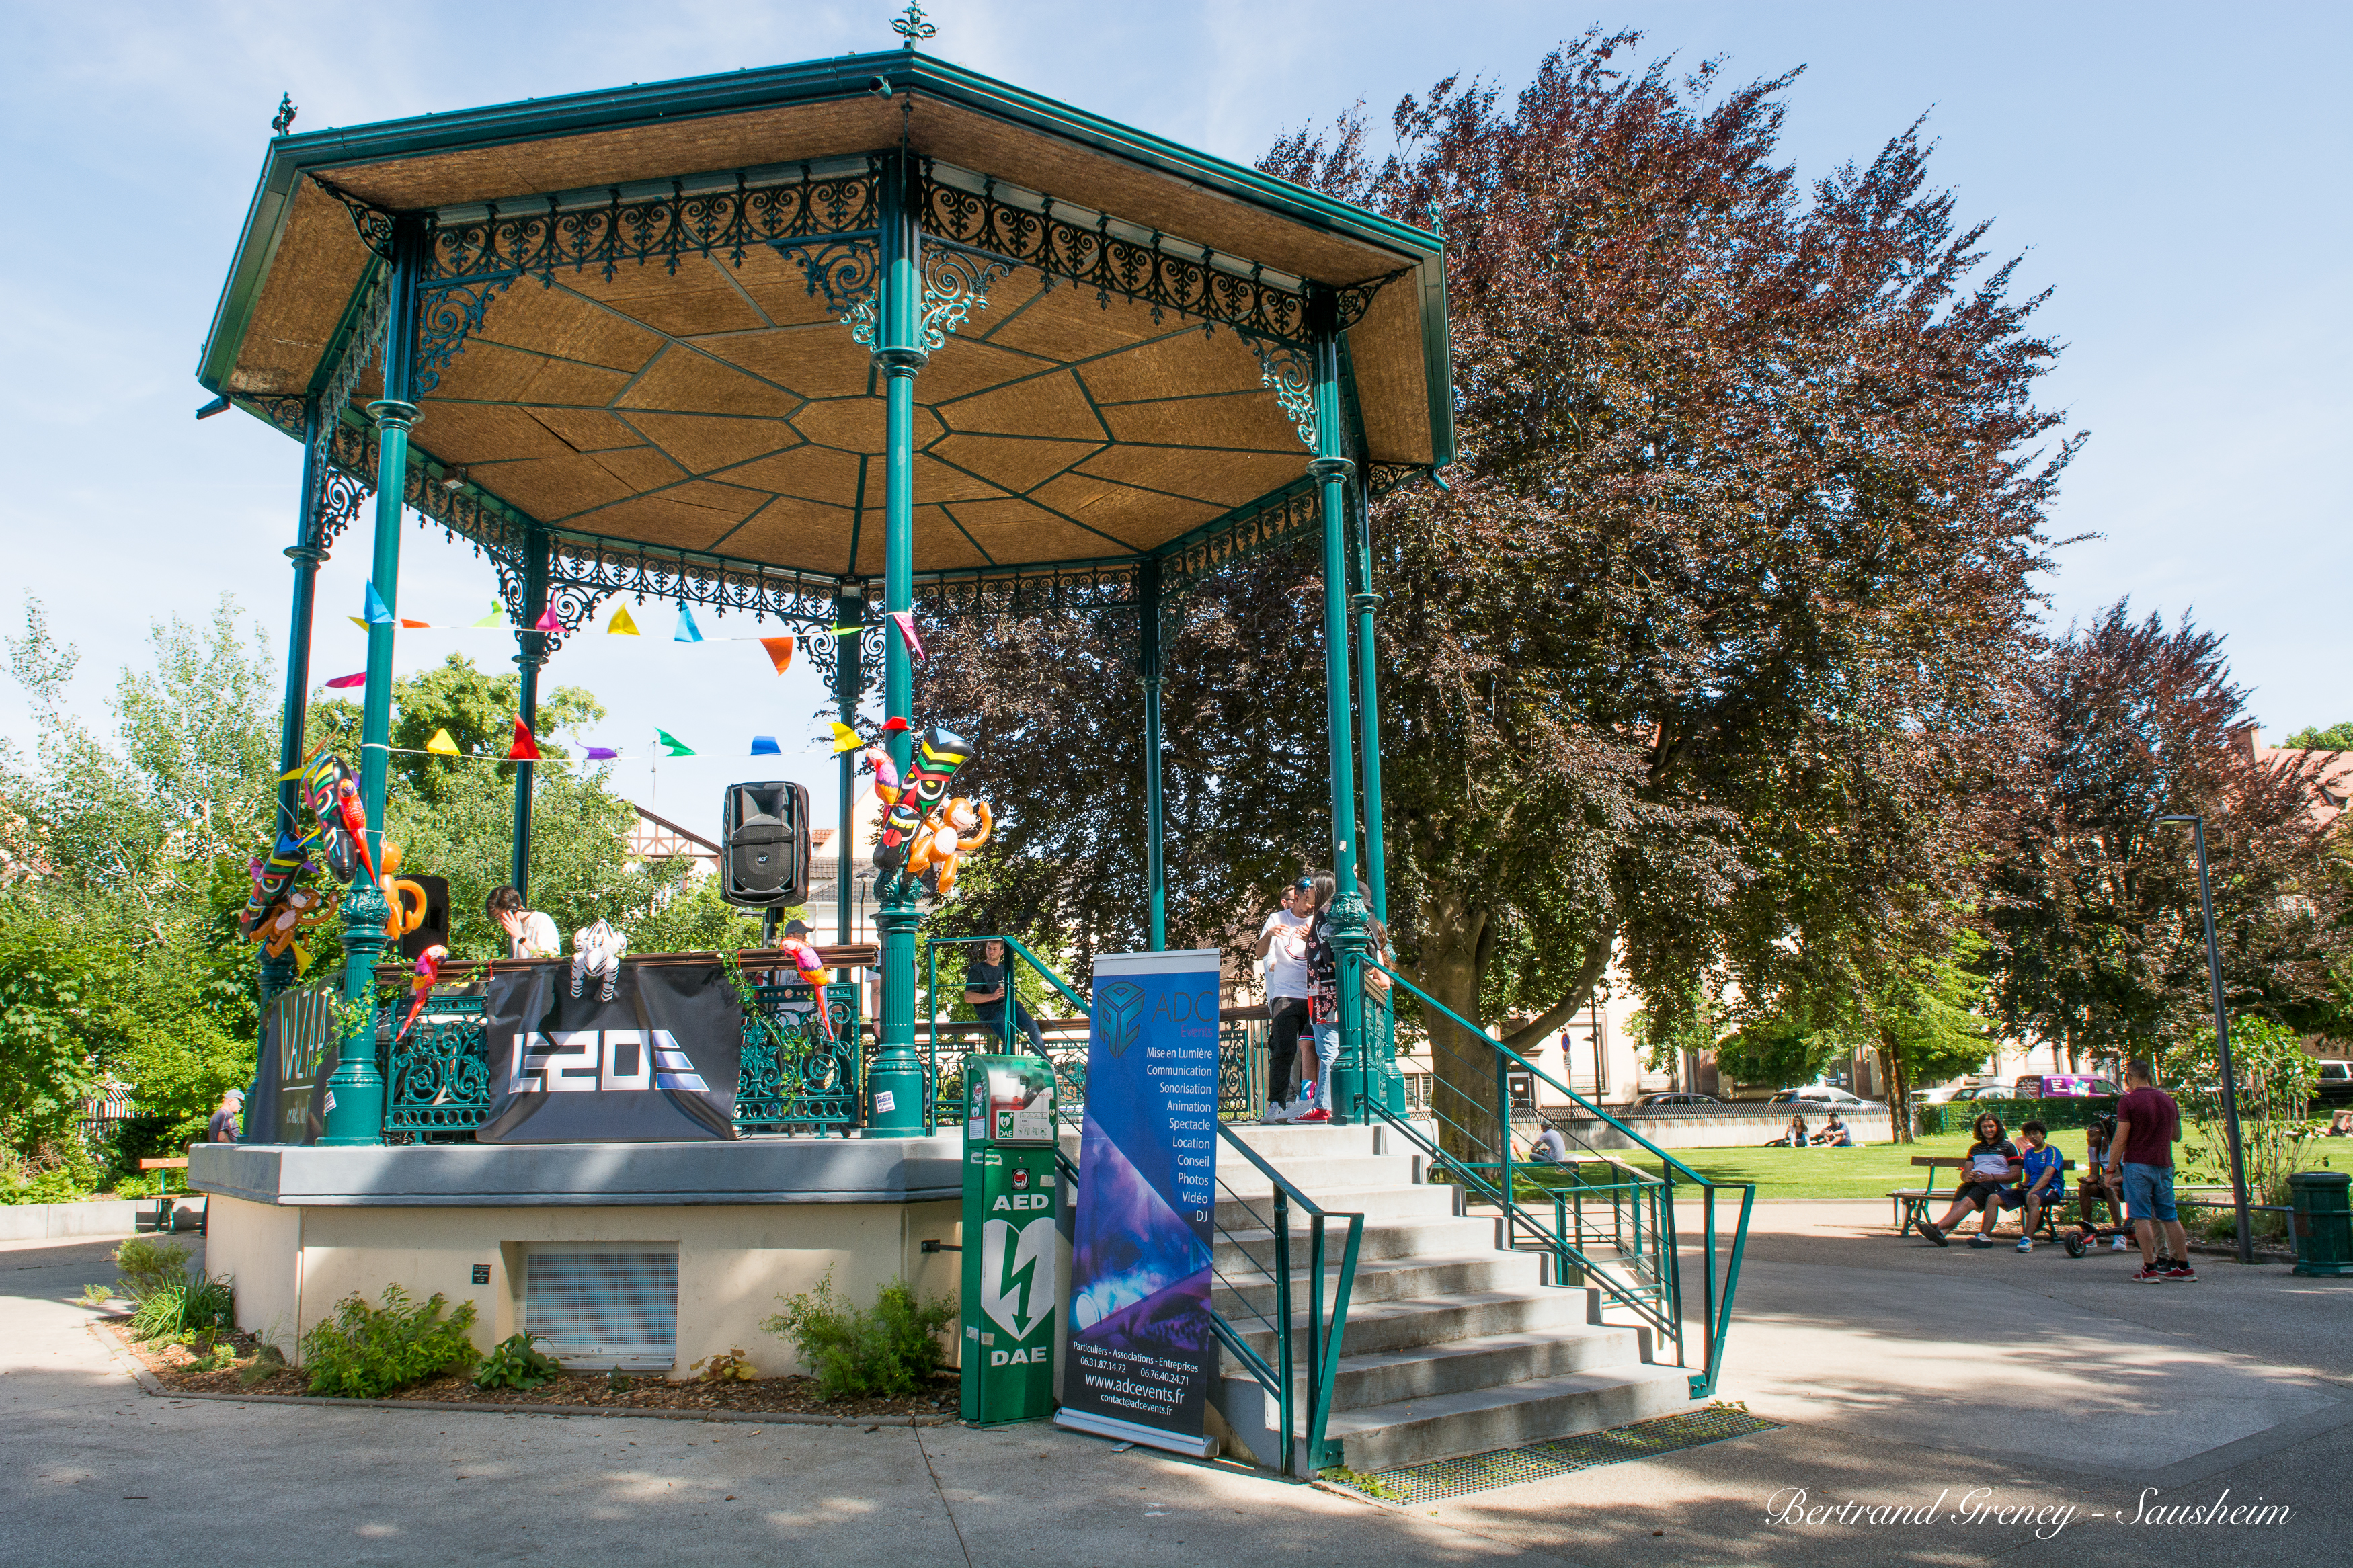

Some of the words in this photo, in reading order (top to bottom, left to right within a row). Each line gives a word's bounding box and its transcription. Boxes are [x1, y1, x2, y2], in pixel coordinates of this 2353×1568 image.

[1151, 991, 1213, 1022] ADC
[1181, 1024, 1213, 1038] Events
[1146, 1046, 1165, 1058] Mise
[1166, 1049, 1176, 1059] en
[1179, 1047, 1213, 1059] Lumière
[1146, 1064, 1212, 1077] Communication
[1160, 1081, 1211, 1095] Sonorisation
[1167, 1100, 1211, 1113] Animation
[1169, 1117, 1211, 1131] Spectacle
[1172, 1136, 1210, 1149] Location
[1177, 1154, 1209, 1167] Conseil
[1178, 1172, 1209, 1186] Photos
[992, 1194, 1049, 1212] AED
[1182, 1190, 1208, 1204] Vidéo
[1196, 1210, 1207, 1223] DJ
[990, 1346, 1047, 1367] DAE
[1073, 1341, 1107, 1356] Particuliers
[1112, 1348, 1154, 1364] Associations
[1159, 1357, 1199, 1373] Entreprises
[1080, 1356, 1126, 1373] 06.31.87.14.72
[1140, 1368, 1189, 1386] 06.76.40.24.71
[1085, 1374, 1185, 1405] www.adcevents.fr
[1101, 1394, 1172, 1415] contact@adcevents.fr
